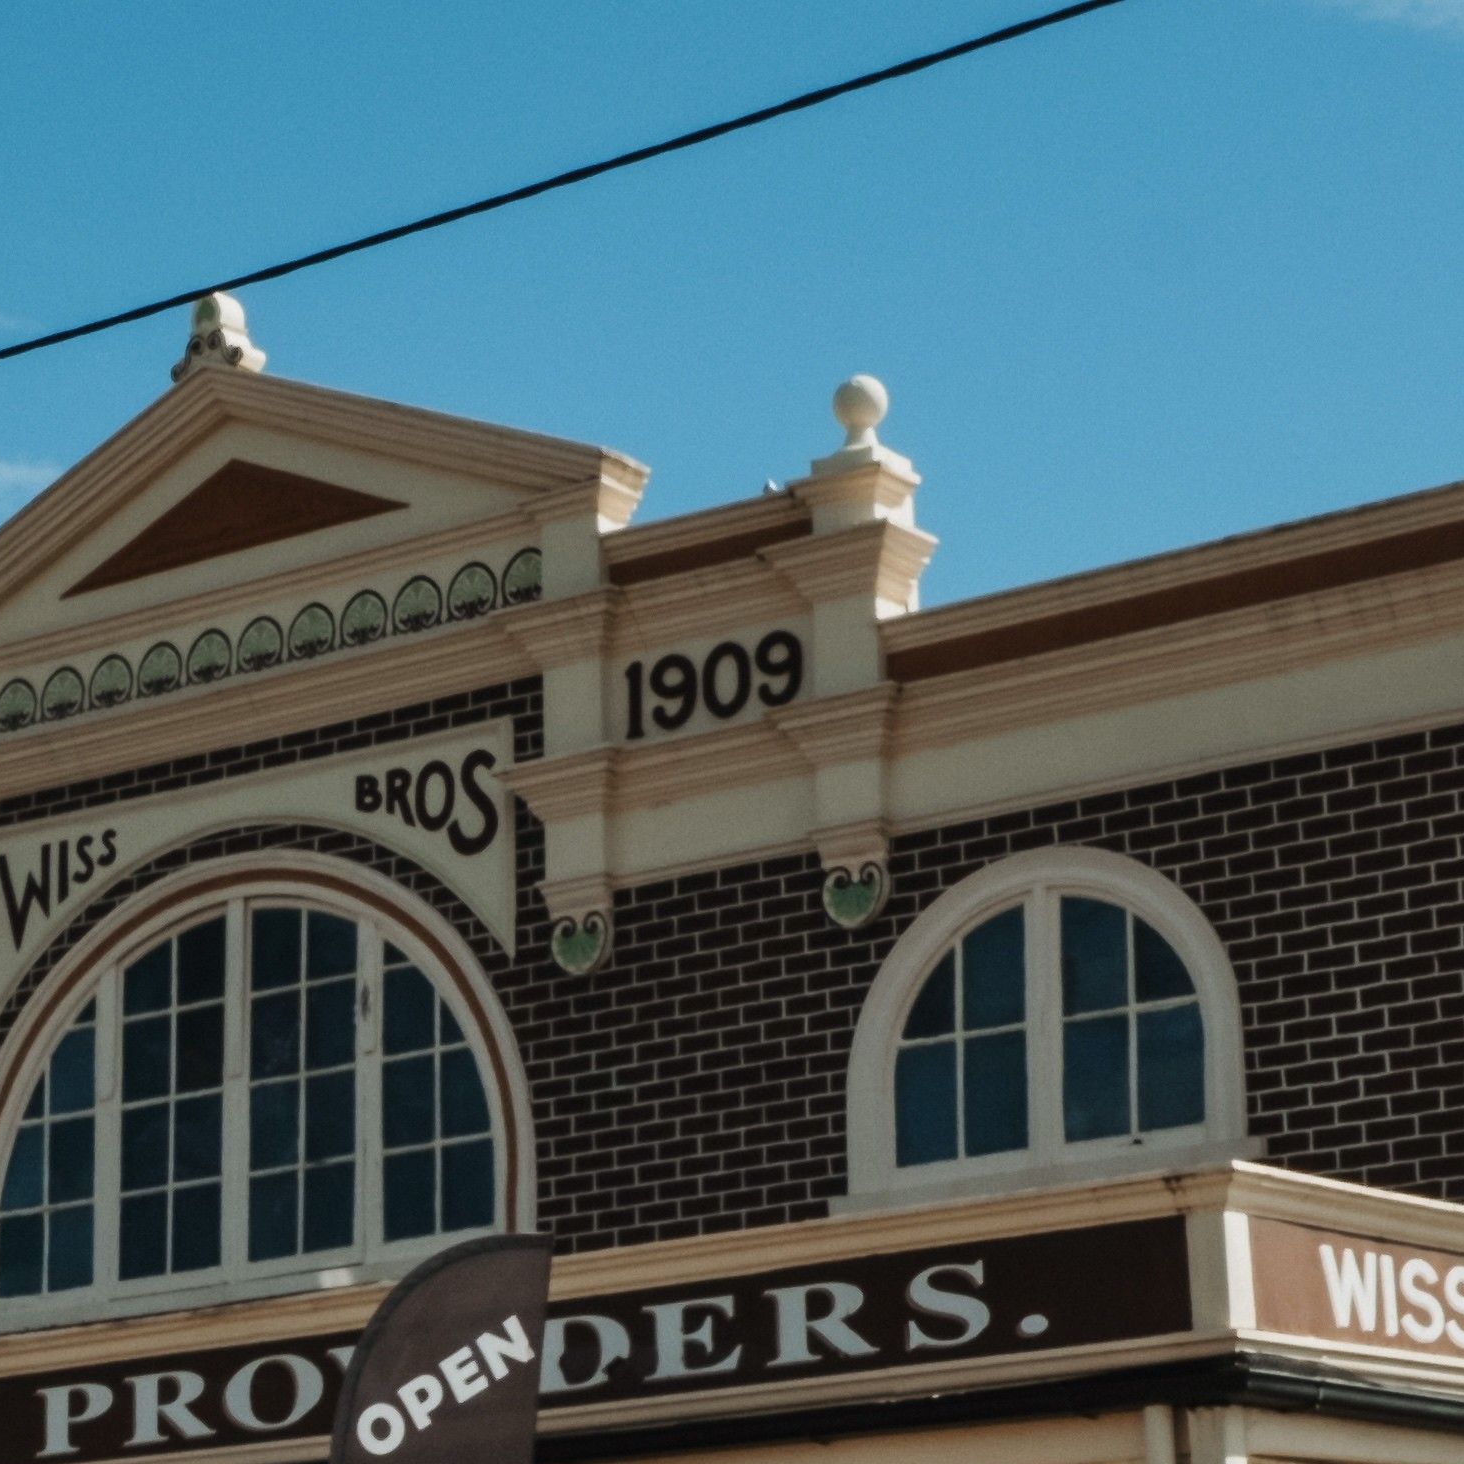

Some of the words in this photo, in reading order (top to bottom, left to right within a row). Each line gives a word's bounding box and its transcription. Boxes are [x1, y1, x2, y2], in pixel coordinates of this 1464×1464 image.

[625, 630, 803, 740] 1909
[354, 748, 499, 856] BROS
[34, 1259, 1051, 1459] PRODERS.
[357, 1315, 535, 1456] OPEN
